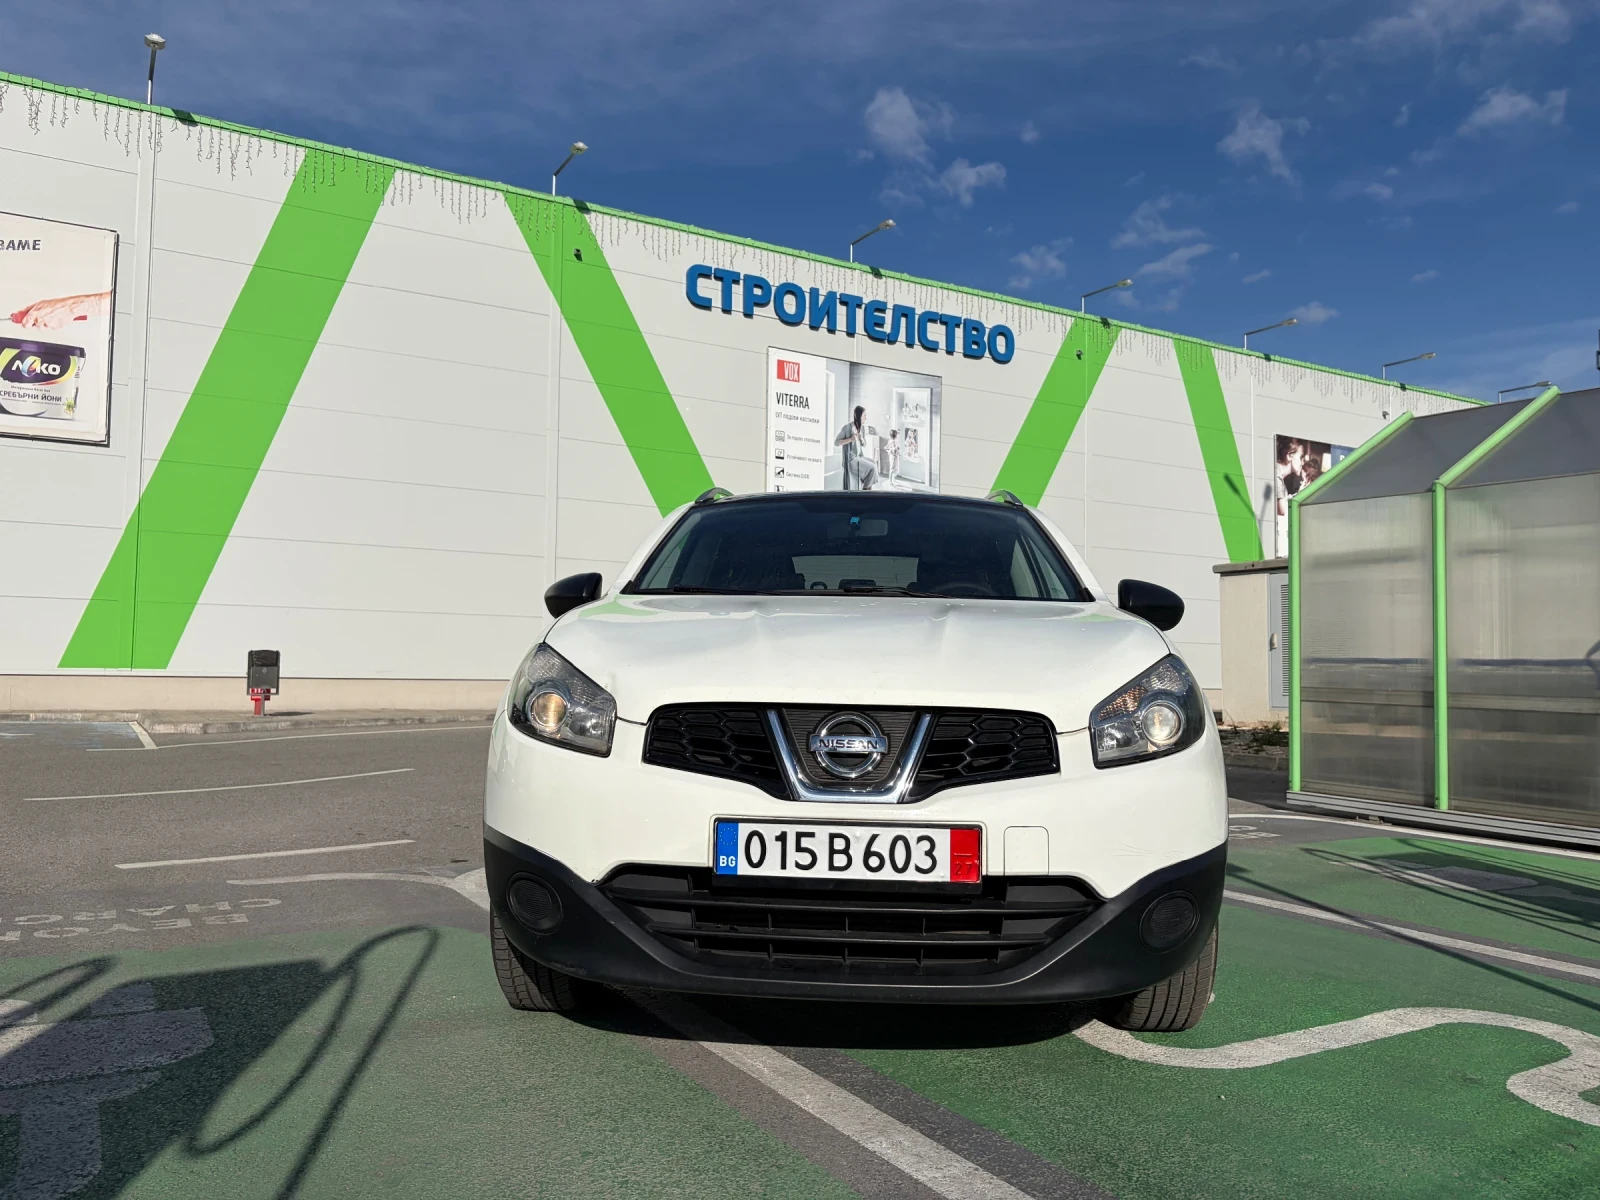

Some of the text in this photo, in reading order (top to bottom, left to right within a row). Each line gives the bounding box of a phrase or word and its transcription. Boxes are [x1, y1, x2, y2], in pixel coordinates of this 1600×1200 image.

[686, 264, 1015, 364] СТРОИТЕЛСТВО
[783, 361, 799, 382] VOX
[0, 390, 39, 400] СРЕБЪРНИ
[41, 393, 62, 403] ЙОНИ
[776, 392, 810, 409] VITERRA
[819, 738, 878, 750] NISSAN
[719, 855, 736, 867] BG
